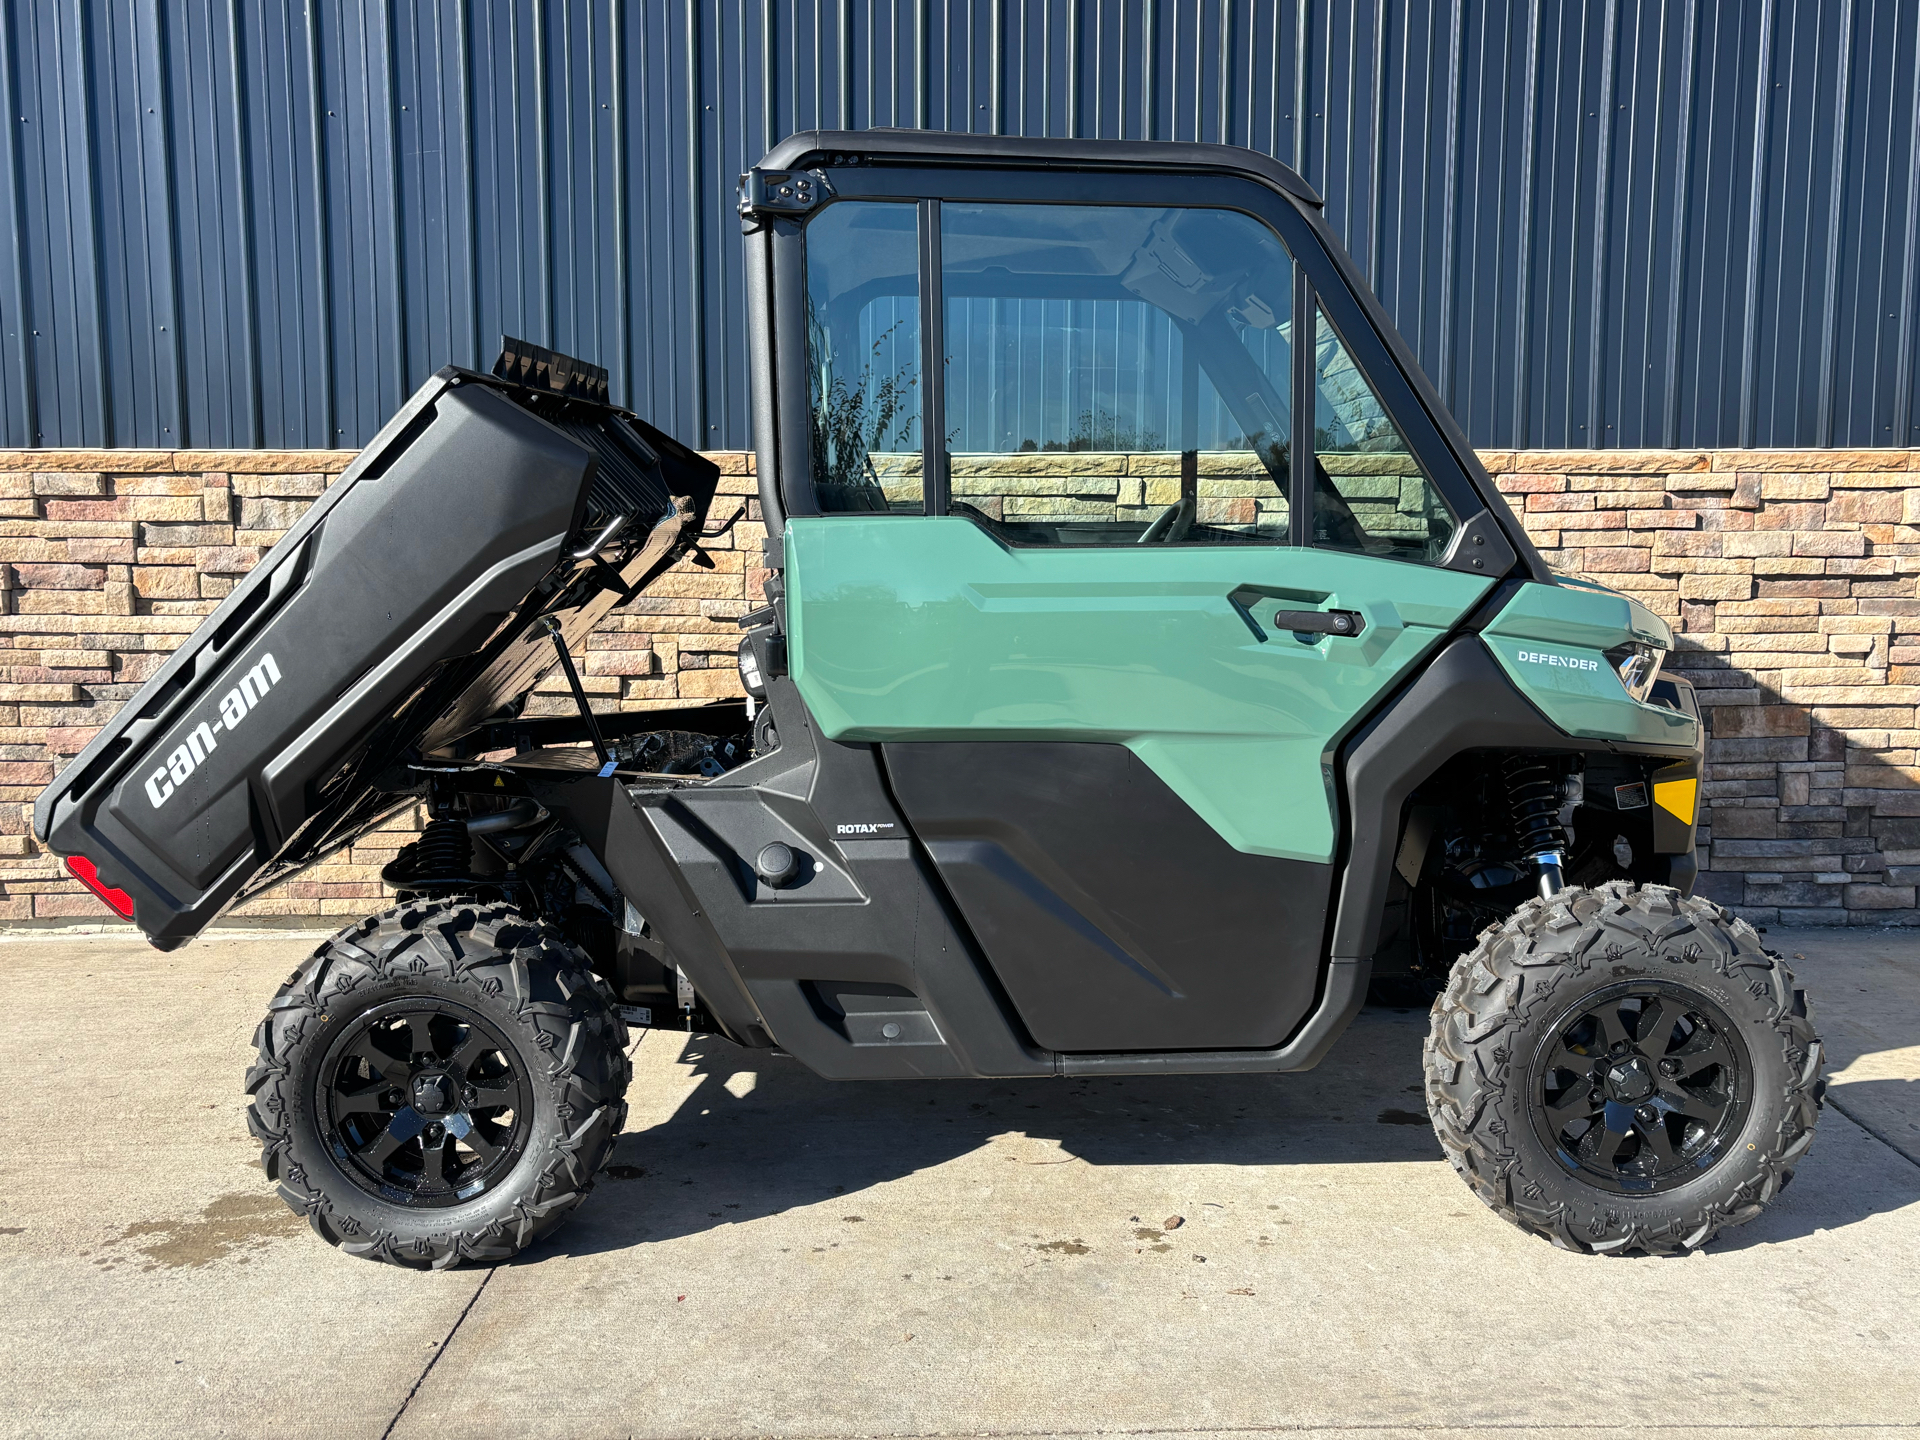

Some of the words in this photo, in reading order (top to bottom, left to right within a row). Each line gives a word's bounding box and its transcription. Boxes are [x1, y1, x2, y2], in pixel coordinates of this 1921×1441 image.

[1518, 650, 1598, 671] DEFENDER
[144, 652, 282, 809] can-am
[837, 823, 878, 834] ROTAX
